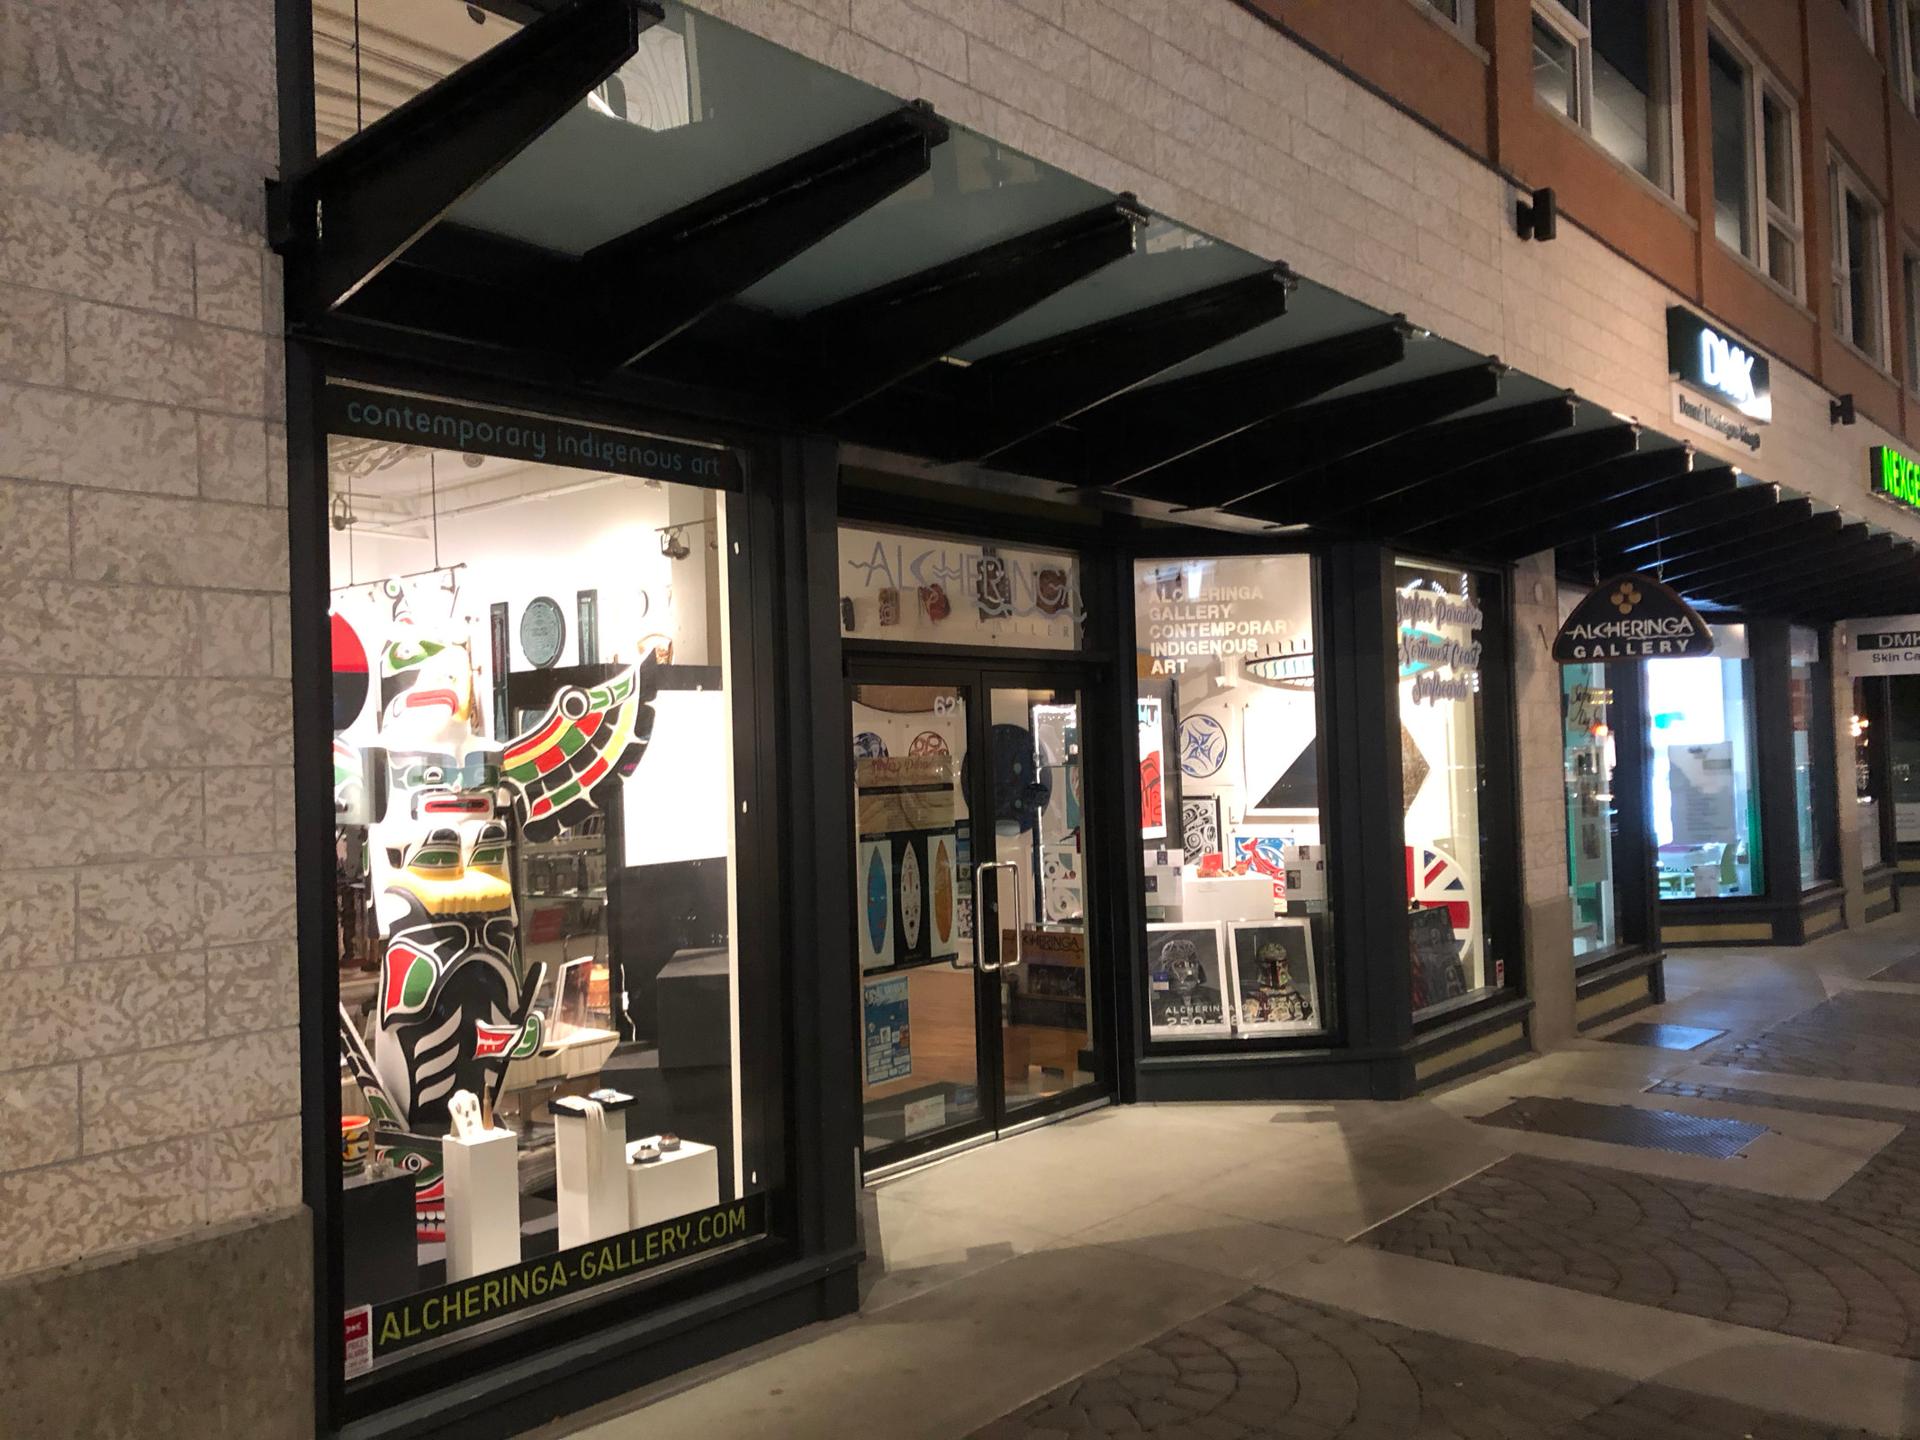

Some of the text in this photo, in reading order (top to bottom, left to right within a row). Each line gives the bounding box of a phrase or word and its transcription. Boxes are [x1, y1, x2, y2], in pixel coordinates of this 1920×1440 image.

[1701, 328, 1757, 403] DMK
[347, 401, 721, 477] contemporary indigenous art
[848, 540, 1087, 621] ALCHERINGA
[1150, 585, 1264, 604] ALCERINGA
[1150, 603, 1233, 621] GALLERY
[1150, 619, 1293, 639] CONTEMPORAR
[1565, 615, 1695, 640] ALCHERINGA
[1150, 638, 1259, 657] INDIGENOUS
[1573, 639, 1690, 659] GALLERY
[1872, 652, 1900, 663] Skin
[1151, 658, 1189, 675] ART
[379, 1206, 747, 1346] ALCHERINGA-GALLERY.COM
